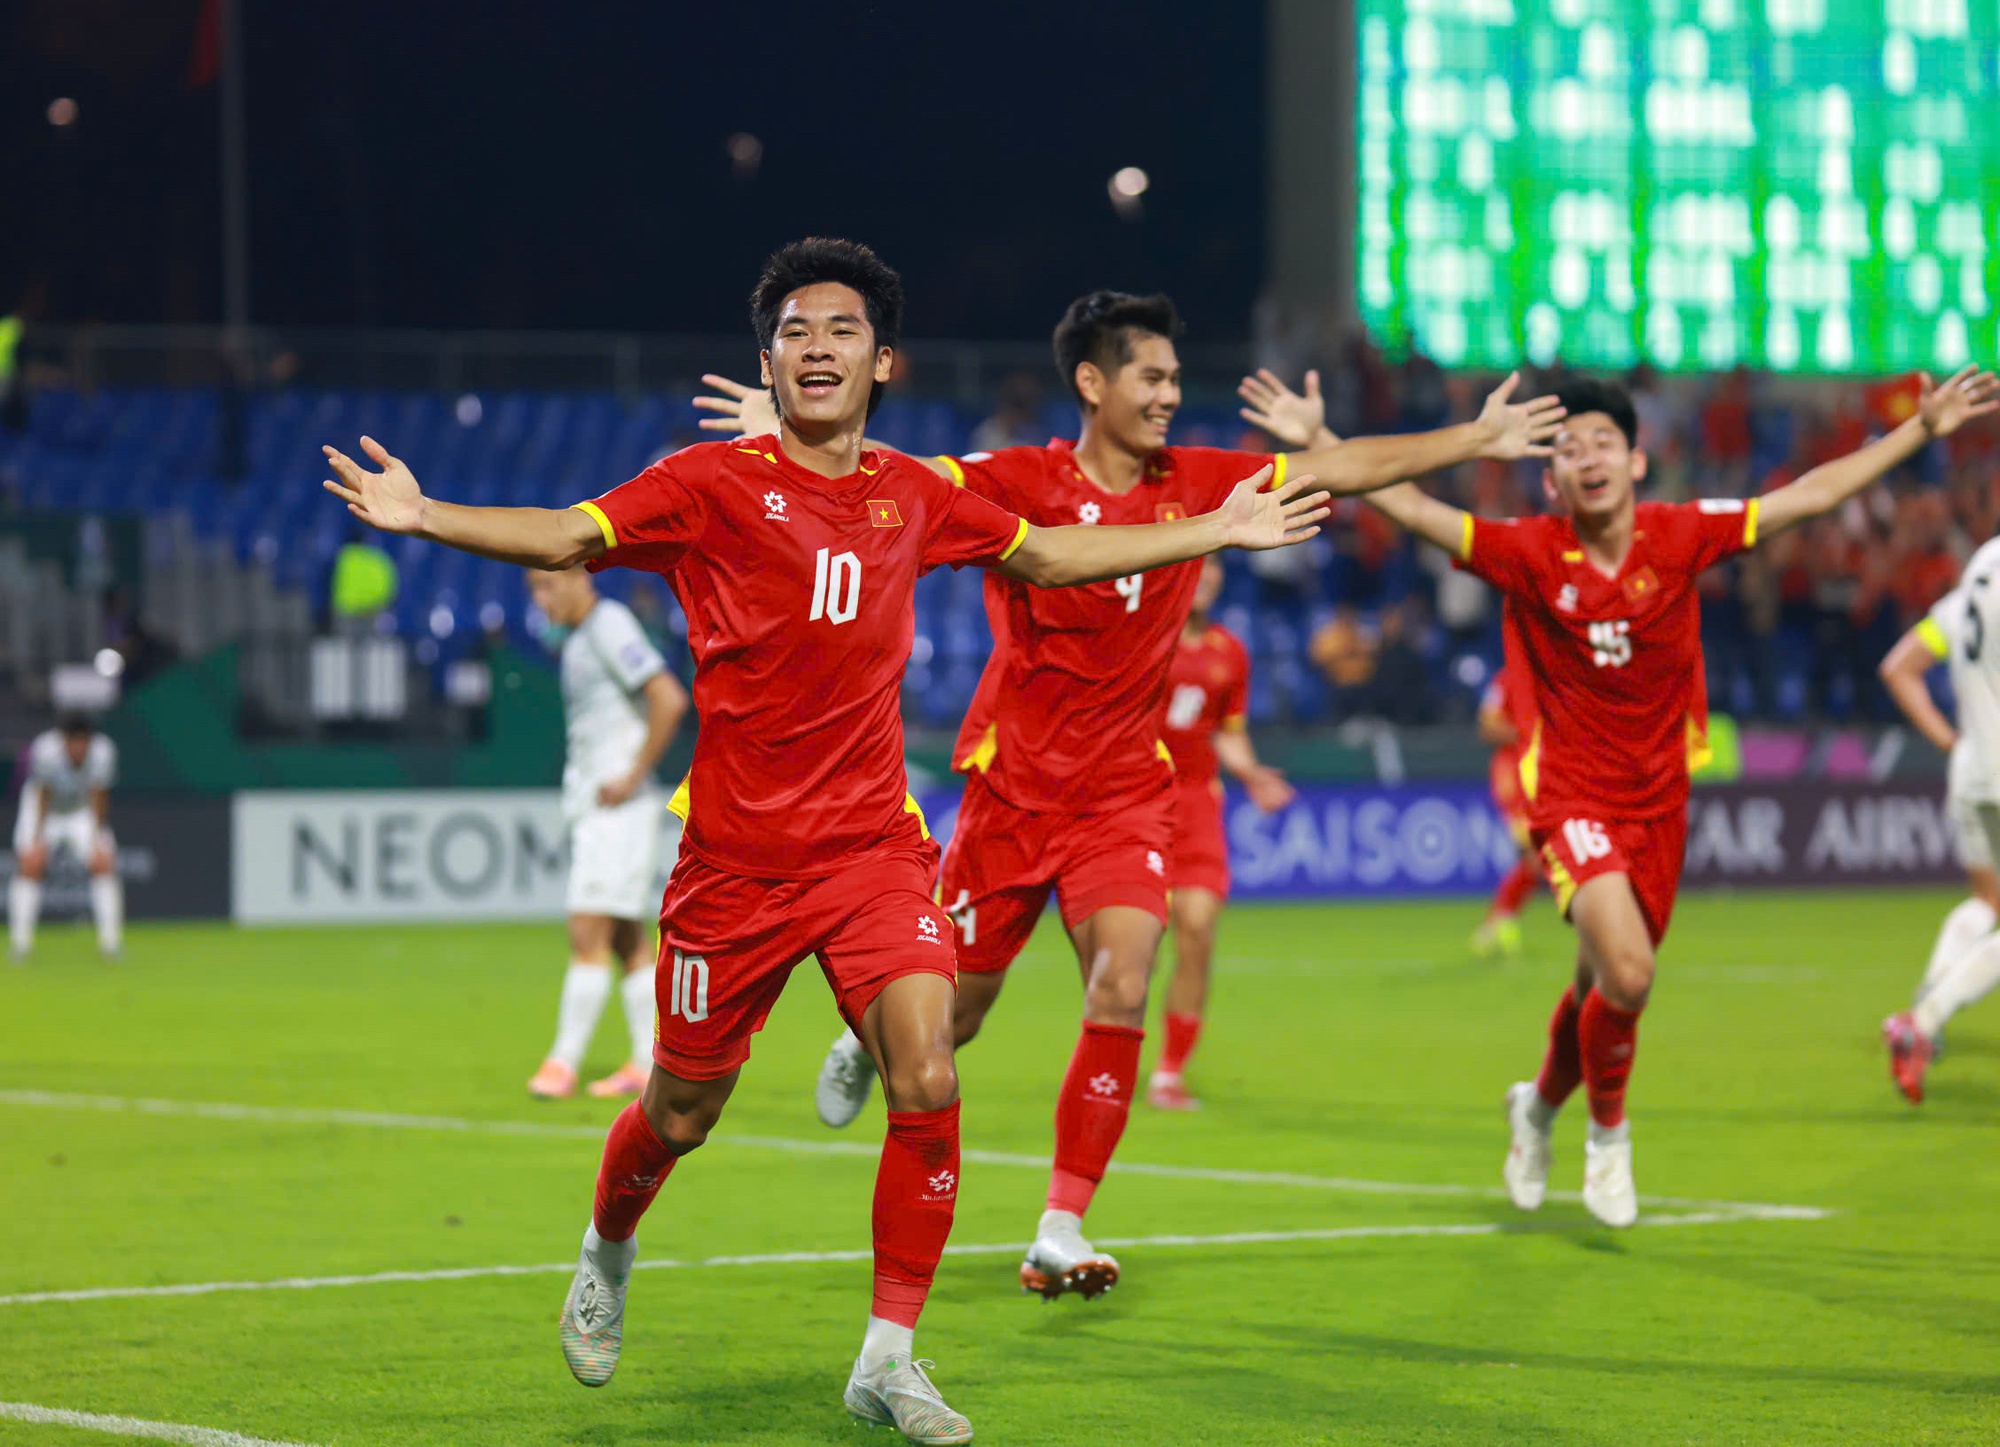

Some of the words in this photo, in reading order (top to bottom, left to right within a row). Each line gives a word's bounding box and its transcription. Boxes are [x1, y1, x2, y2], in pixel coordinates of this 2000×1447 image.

[808, 547, 862, 625] 10
[291, 811, 573, 901] NEOM
[1228, 797, 1516, 887] SAISON
[1562, 818, 1612, 866] 16
[671, 949, 709, 1023] 10
